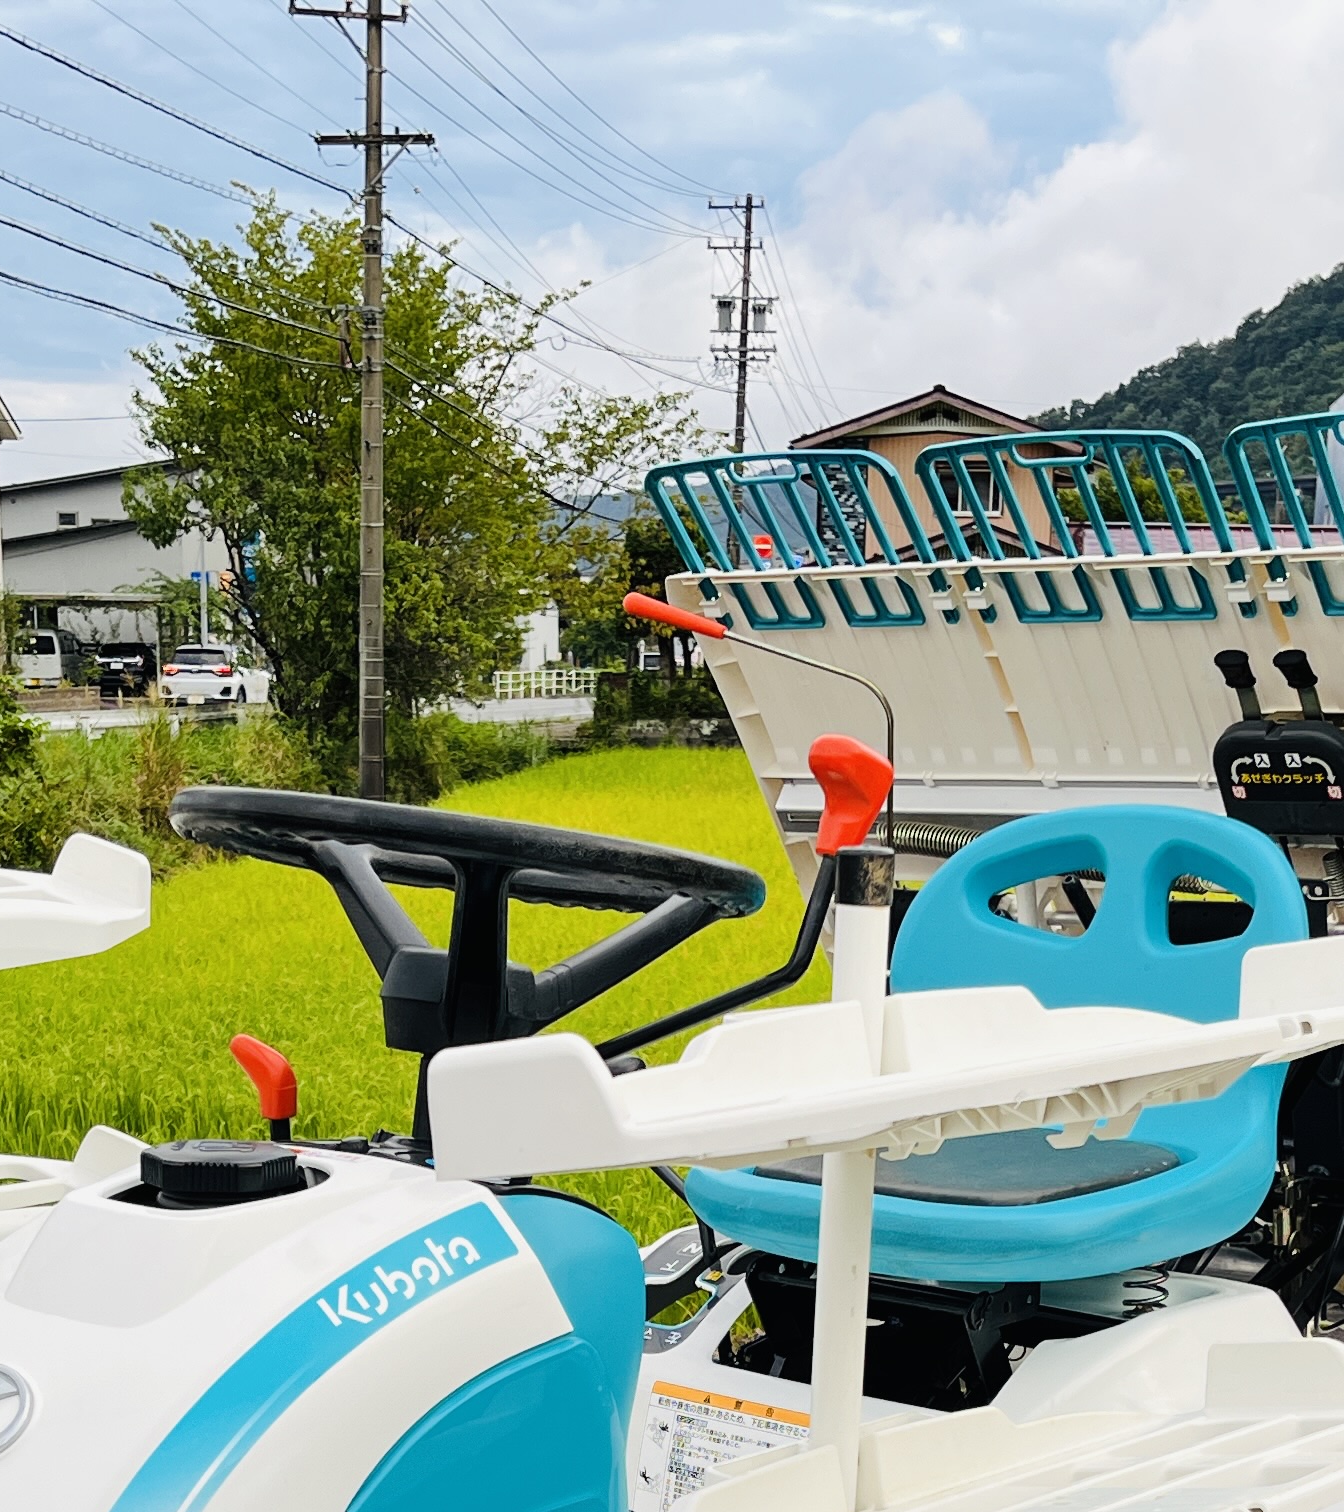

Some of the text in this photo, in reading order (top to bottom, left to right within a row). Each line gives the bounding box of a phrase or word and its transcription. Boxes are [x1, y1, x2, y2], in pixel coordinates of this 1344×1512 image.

[1256, 754, 1301, 767] 入 入
[316, 1236, 481, 1327] Kubota
